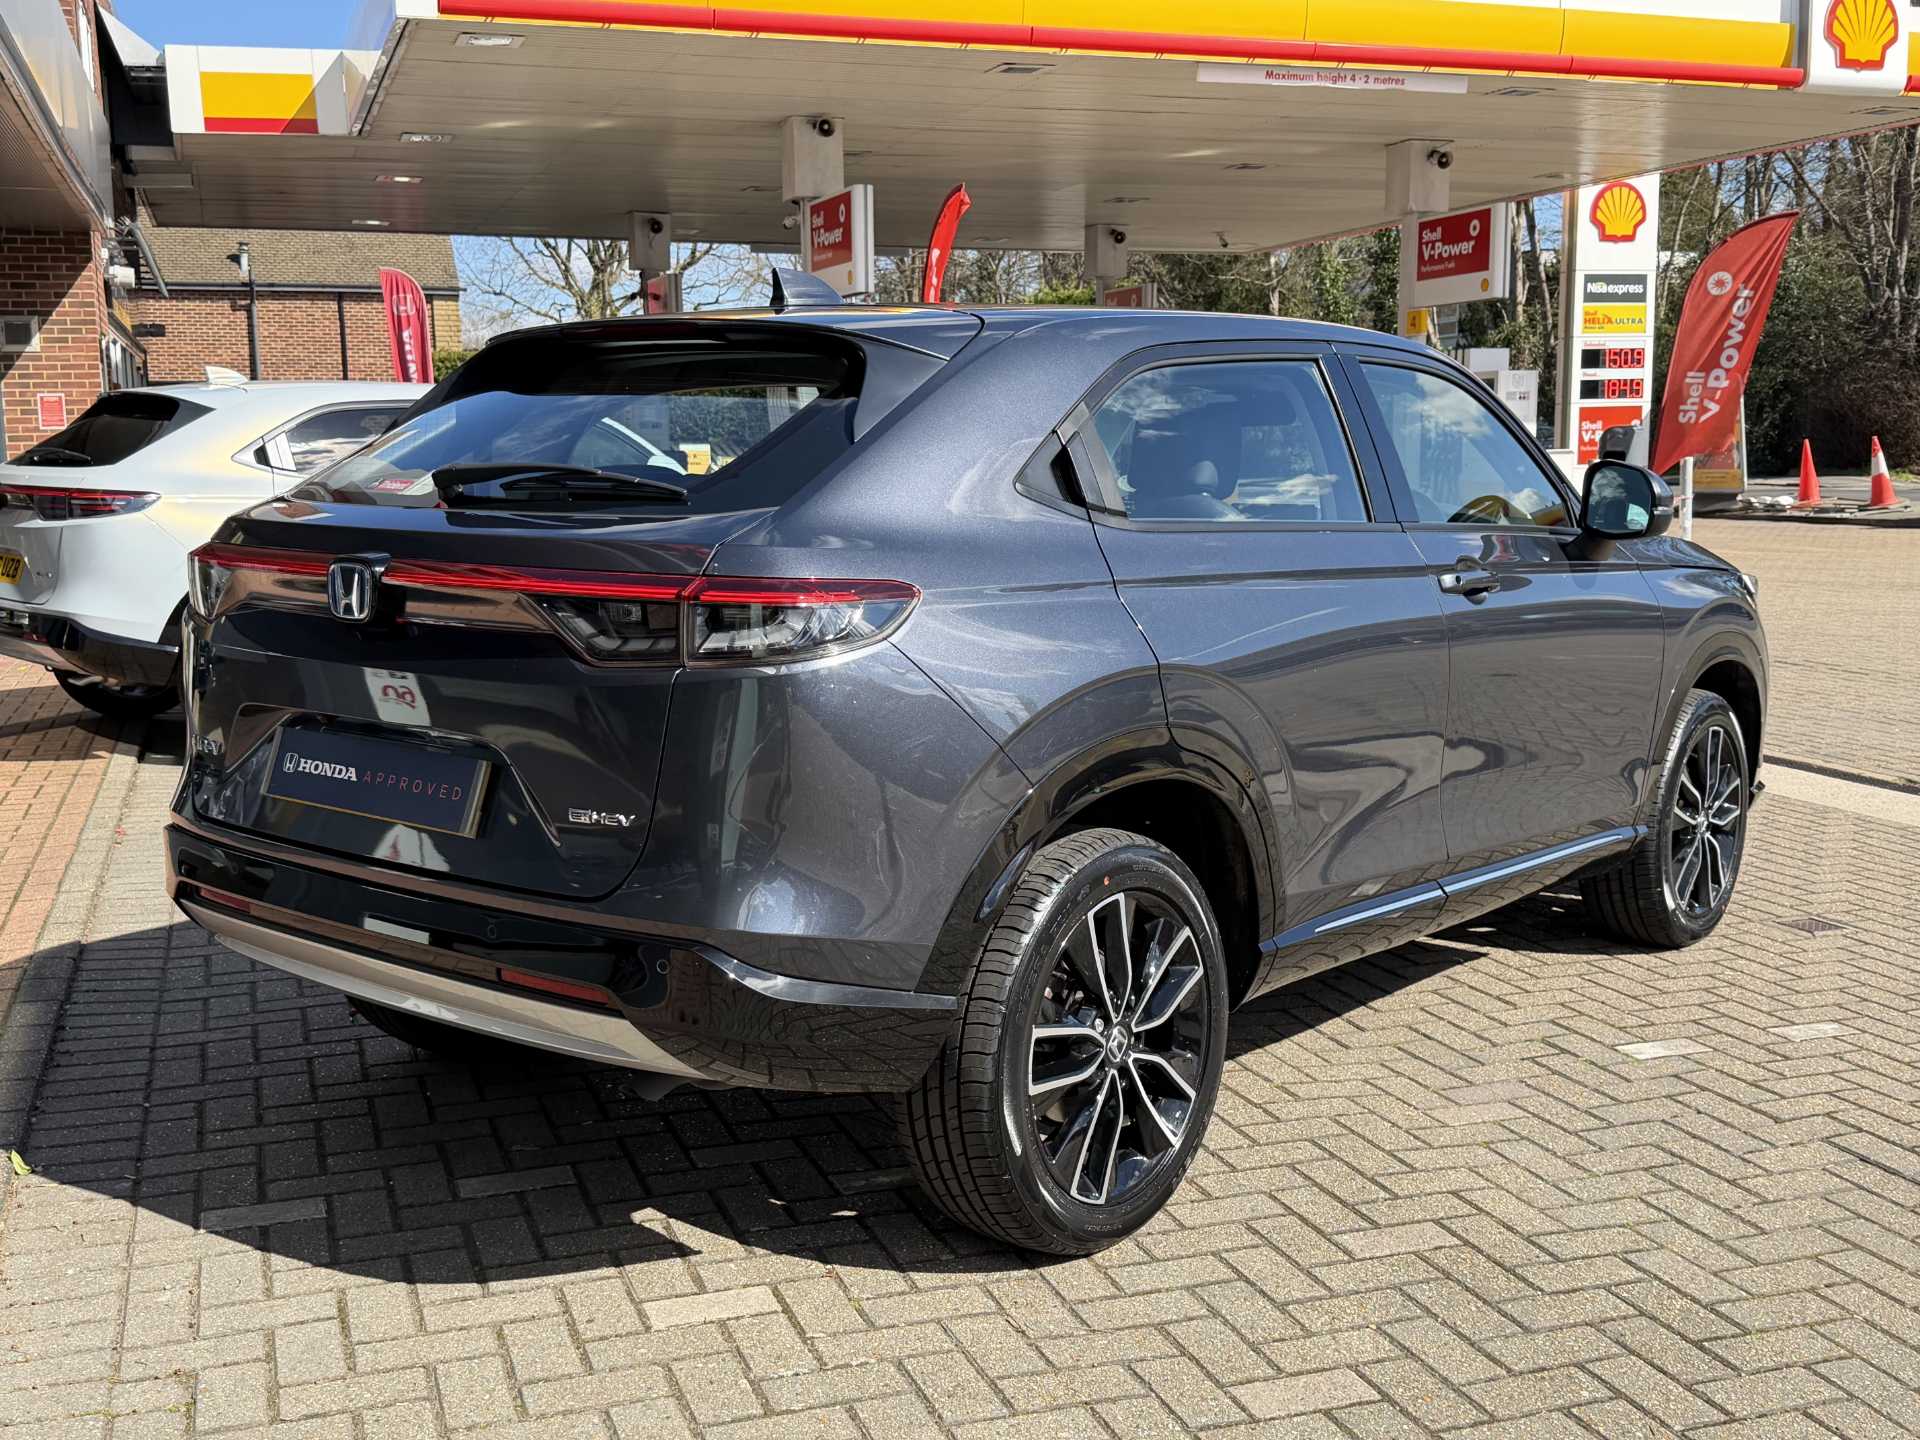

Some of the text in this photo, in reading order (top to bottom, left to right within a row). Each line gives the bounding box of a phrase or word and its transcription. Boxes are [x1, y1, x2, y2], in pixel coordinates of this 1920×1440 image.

[1265, 70, 1313, 81] Maximum
[1317, 71, 1346, 84] height
[1373, 76, 1406, 86] metres
[812, 210, 824, 228] Shell
[812, 226, 844, 249] V-Power
[1421, 225, 1442, 242] Shell
[1421, 239, 1476, 261] V-Power
[1586, 281, 1644, 295] Nisa express
[1615, 317, 1643, 325] ULTRA
[1605, 348, 1644, 369] 150.9
[1698, 282, 1755, 424] V-Power
[1604, 379, 1643, 400] 184.9
[1678, 371, 1706, 424] Shell
[1581, 420, 1603, 430] Shell
[298, 757, 462, 801] HONDA APPROVED
